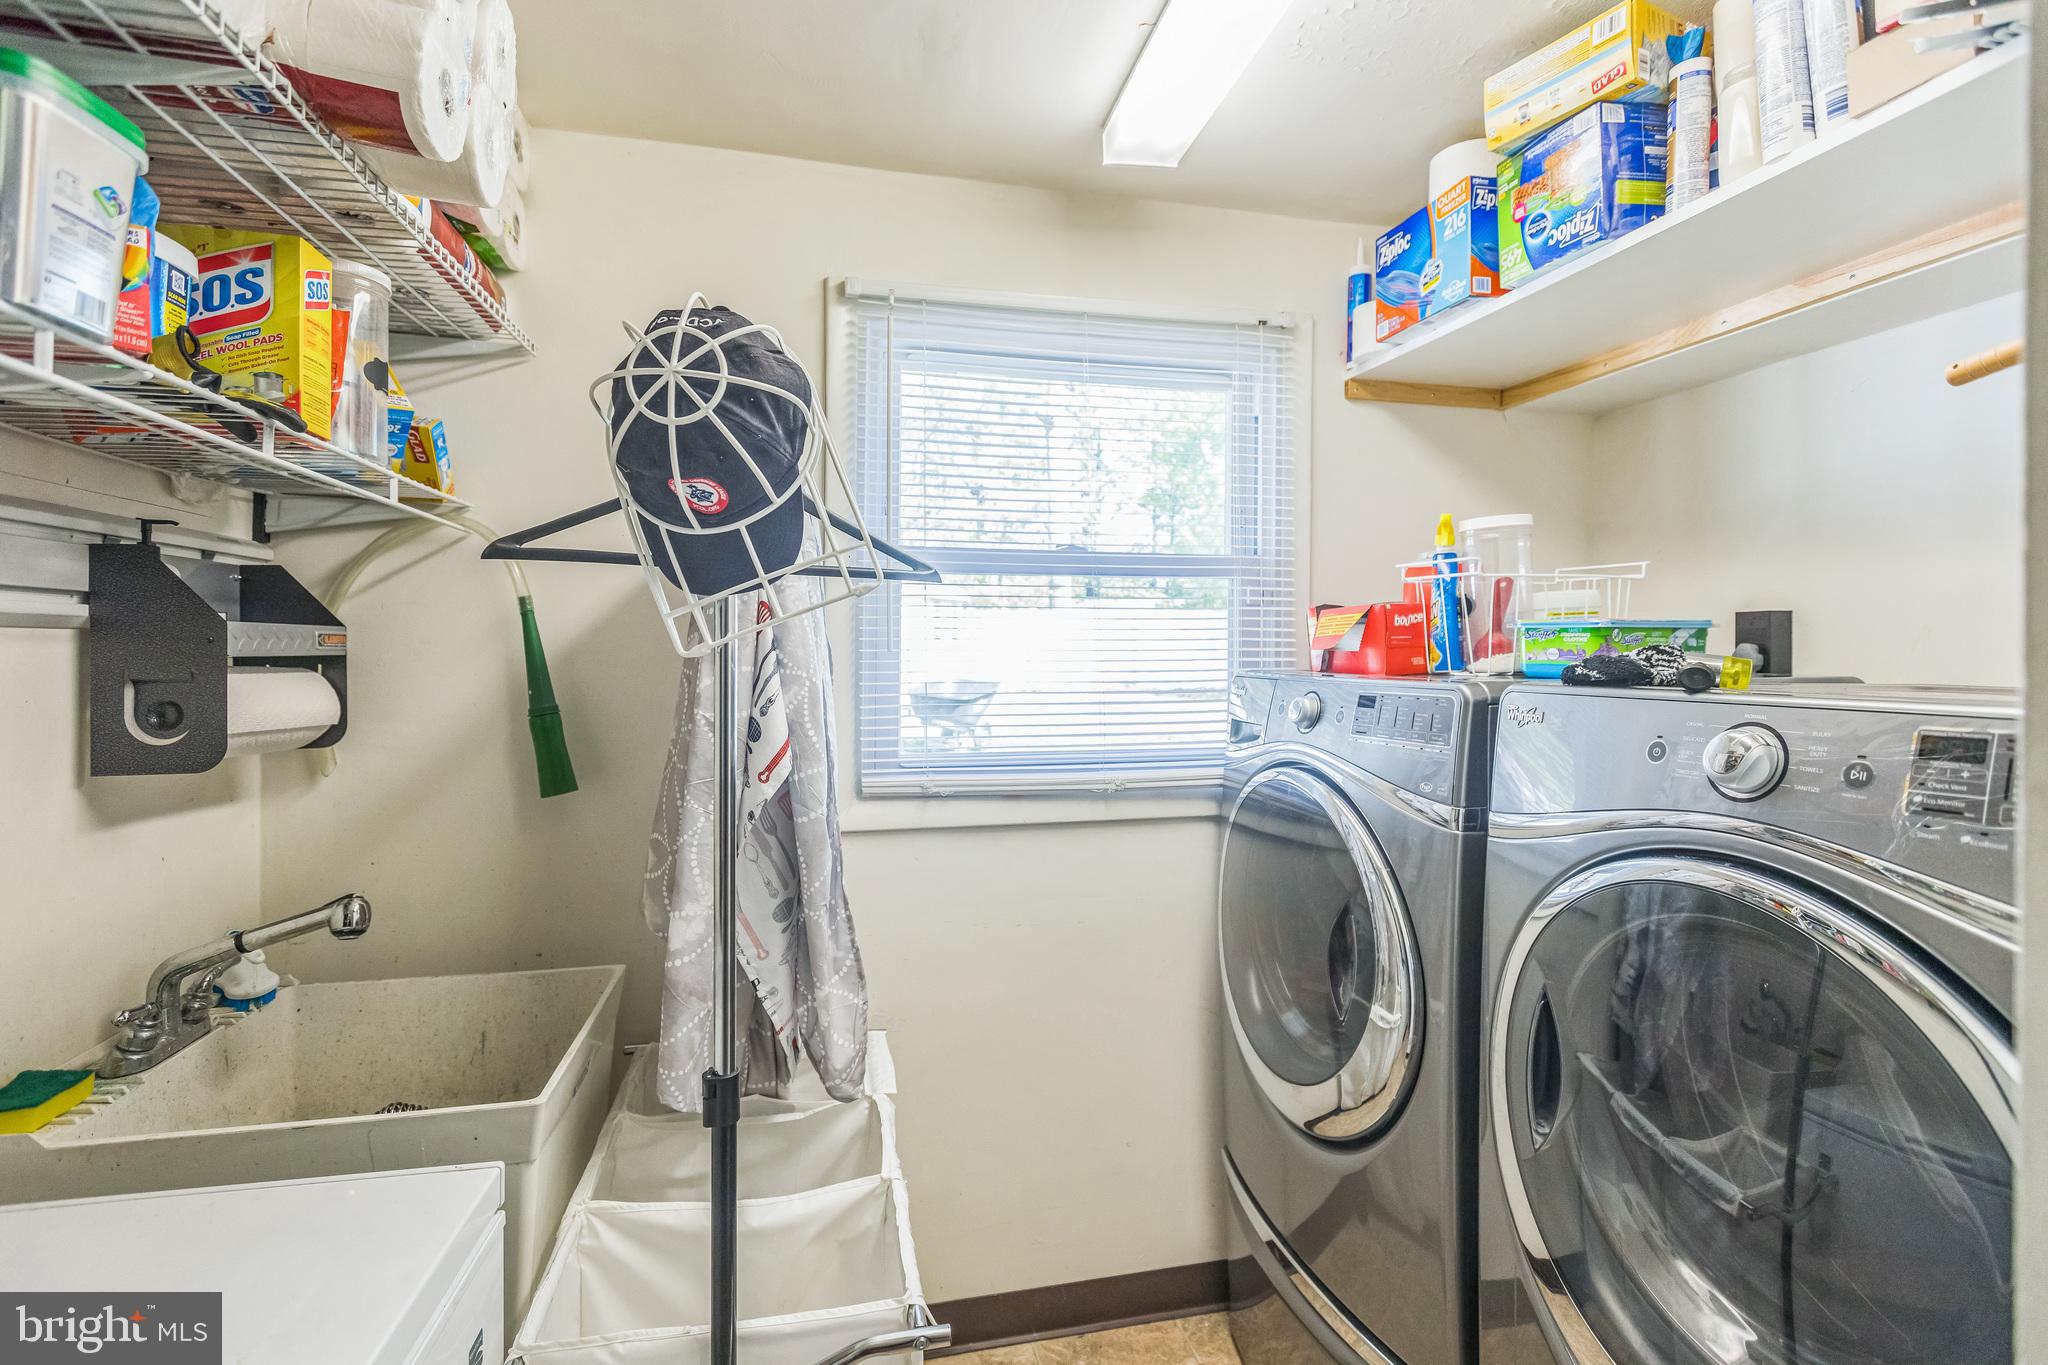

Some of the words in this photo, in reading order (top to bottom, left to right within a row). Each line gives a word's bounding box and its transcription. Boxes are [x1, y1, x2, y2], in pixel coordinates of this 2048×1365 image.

[1593, 63, 1626, 94] GLAD
[1437, 181, 1467, 208] QUART
[1443, 209, 1467, 237] 216
[1548, 207, 1595, 246] Ziploc
[1379, 234, 1412, 266] Ziploc
[307, 281, 329, 300] SOS
[226, 332, 242, 342] Soap
[242, 328, 260, 338] Filled
[216, 340, 251, 355] WOOL
[253, 333, 284, 347] PADS
[248, 350, 260, 358] Soap
[261, 345, 284, 353] Required
[228, 365, 250, 373] Removes
[251, 360, 276, 368] Baked-On
[240, 357, 261, 366] Through
[408, 430, 427, 463] GLAD
[1394, 612, 1424, 627] bounce
[1524, 629, 1558, 641] Swiffer
[1507, 704, 1545, 728] Whirlpool
[1799, 766, 1824, 774] TOWELS
[1794, 784, 1820, 793] SANITIZE
[1928, 782, 1949, 790] Check
[1951, 783, 1967, 791] Vent
[1923, 797, 1936, 805] Eco
[1937, 799, 1965, 807] Monitor
